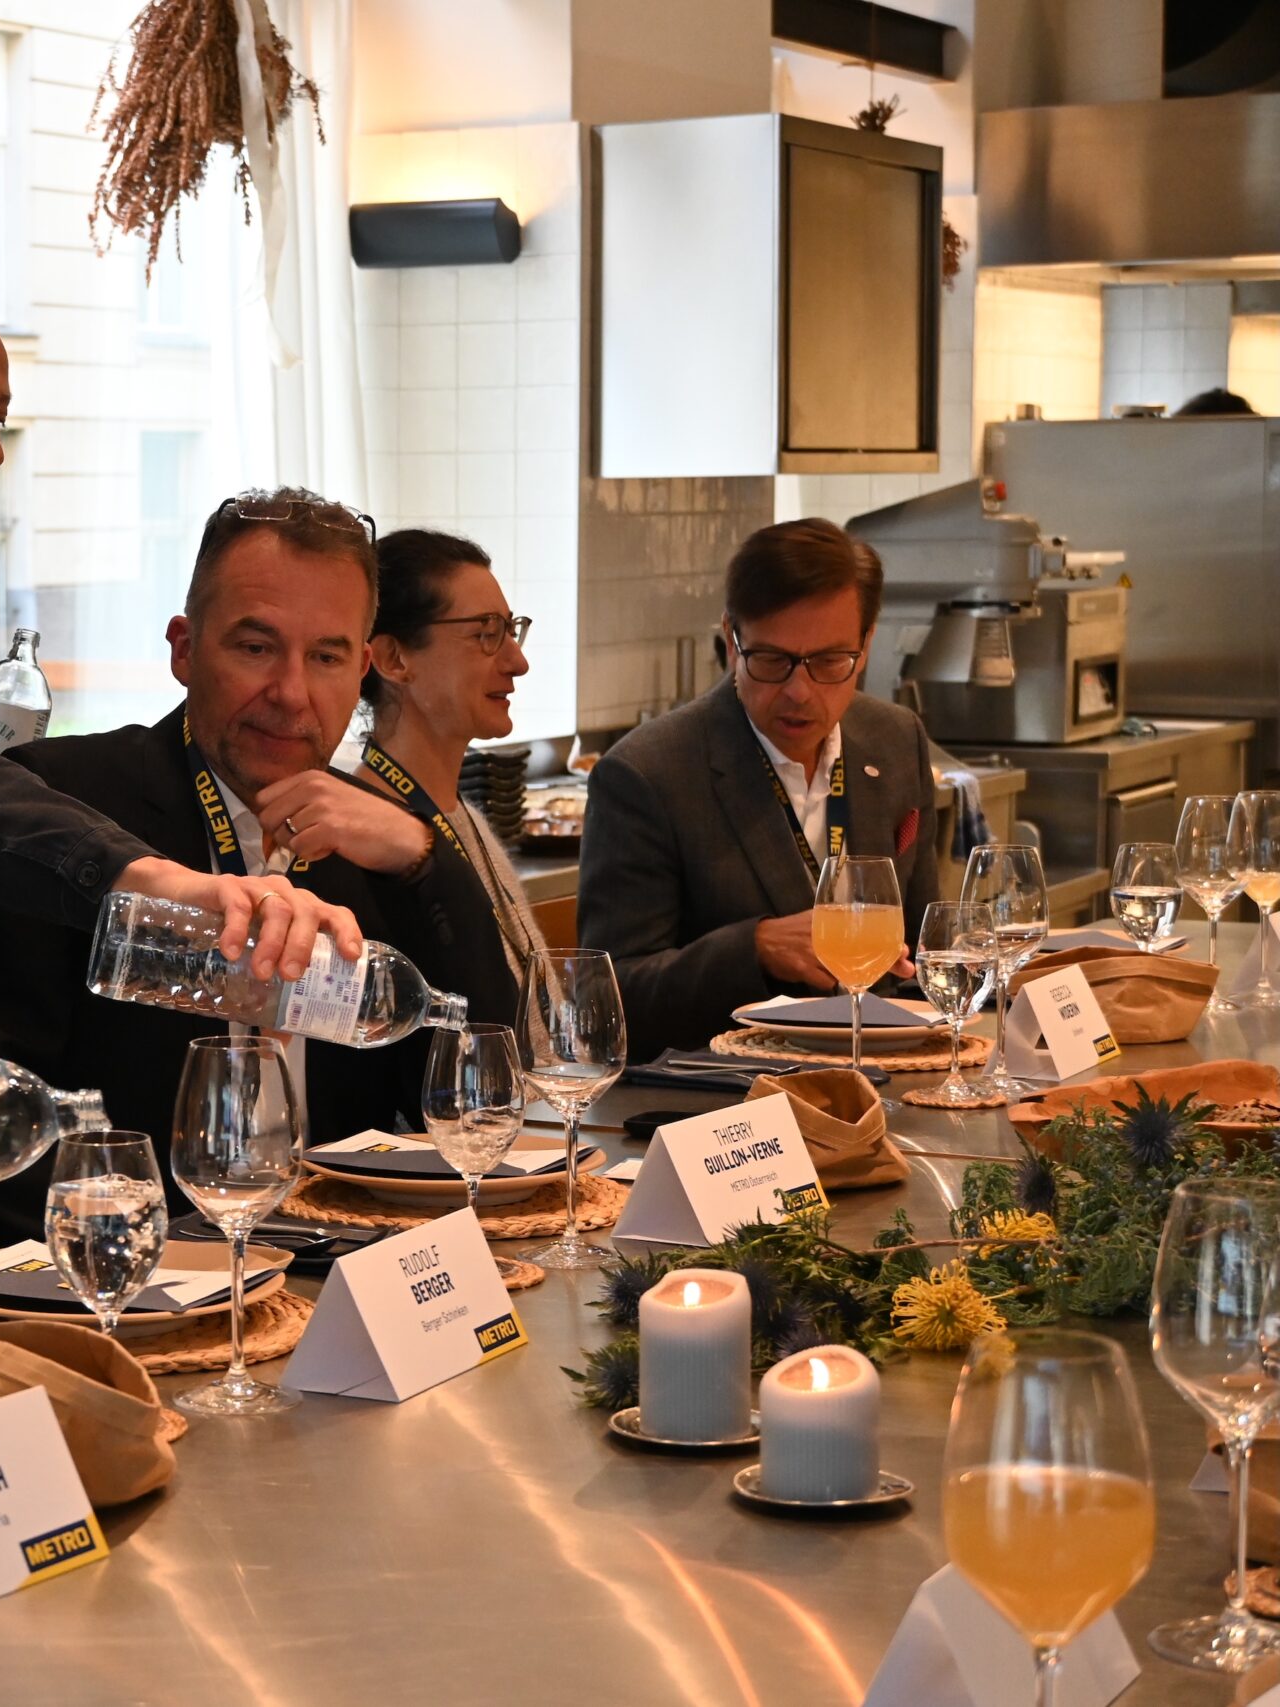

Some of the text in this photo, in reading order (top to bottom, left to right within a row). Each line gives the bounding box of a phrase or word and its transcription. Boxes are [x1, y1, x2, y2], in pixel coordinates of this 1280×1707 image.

[195, 770, 237, 855] METRO
[712, 1120, 755, 1147] THIERRY
[703, 1137, 784, 1176] GUILLON-VERNE
[730, 1179, 749, 1193] METRO
[398, 1244, 441, 1278] RUDOLF
[410, 1271, 455, 1305] BERGER
[421, 1305, 469, 1333] Berger Schinken
[477, 1318, 517, 1348] METRO
[25, 1526, 92, 1566] METRO
